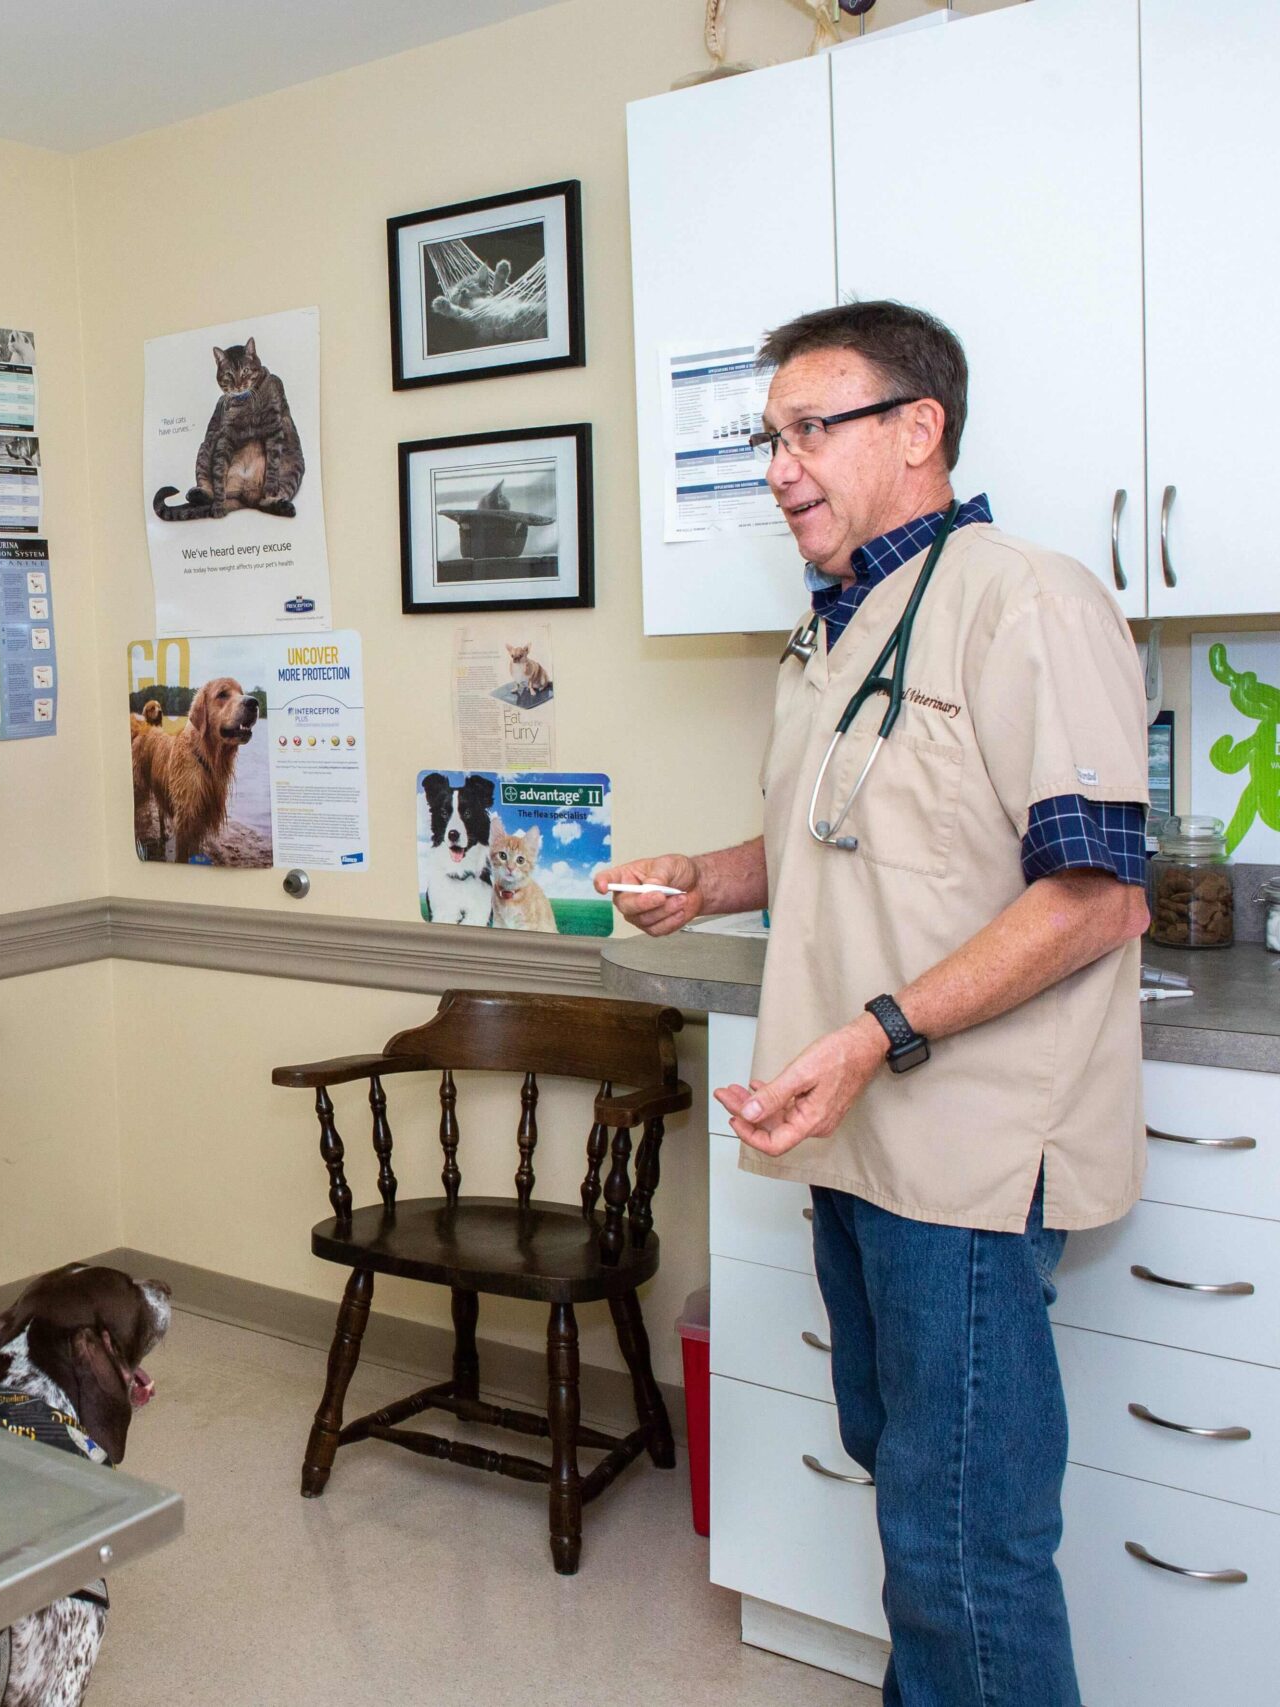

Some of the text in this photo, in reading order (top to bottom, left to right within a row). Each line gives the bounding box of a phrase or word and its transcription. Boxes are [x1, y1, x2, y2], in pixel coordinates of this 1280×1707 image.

[182, 542, 292, 560] We've heard every excuse
[184, 567, 192, 575] Ask
[193, 566, 207, 575] today
[207, 565, 219, 573] how
[220, 564, 235, 573] weight
[254, 562, 265, 570] your
[278, 559, 295, 567] health
[287, 646, 339, 665] UNCOVER
[278, 666, 351, 681] MORE PROTECTION
[294, 707, 340, 715] INTERCEPTOR
[909, 689, 961, 719] Veterinary
[504, 710, 521, 724] Fat
[504, 724, 539, 744] Furry
[588, 790, 600, 804] II
[518, 809, 587, 820] The flea specialist
